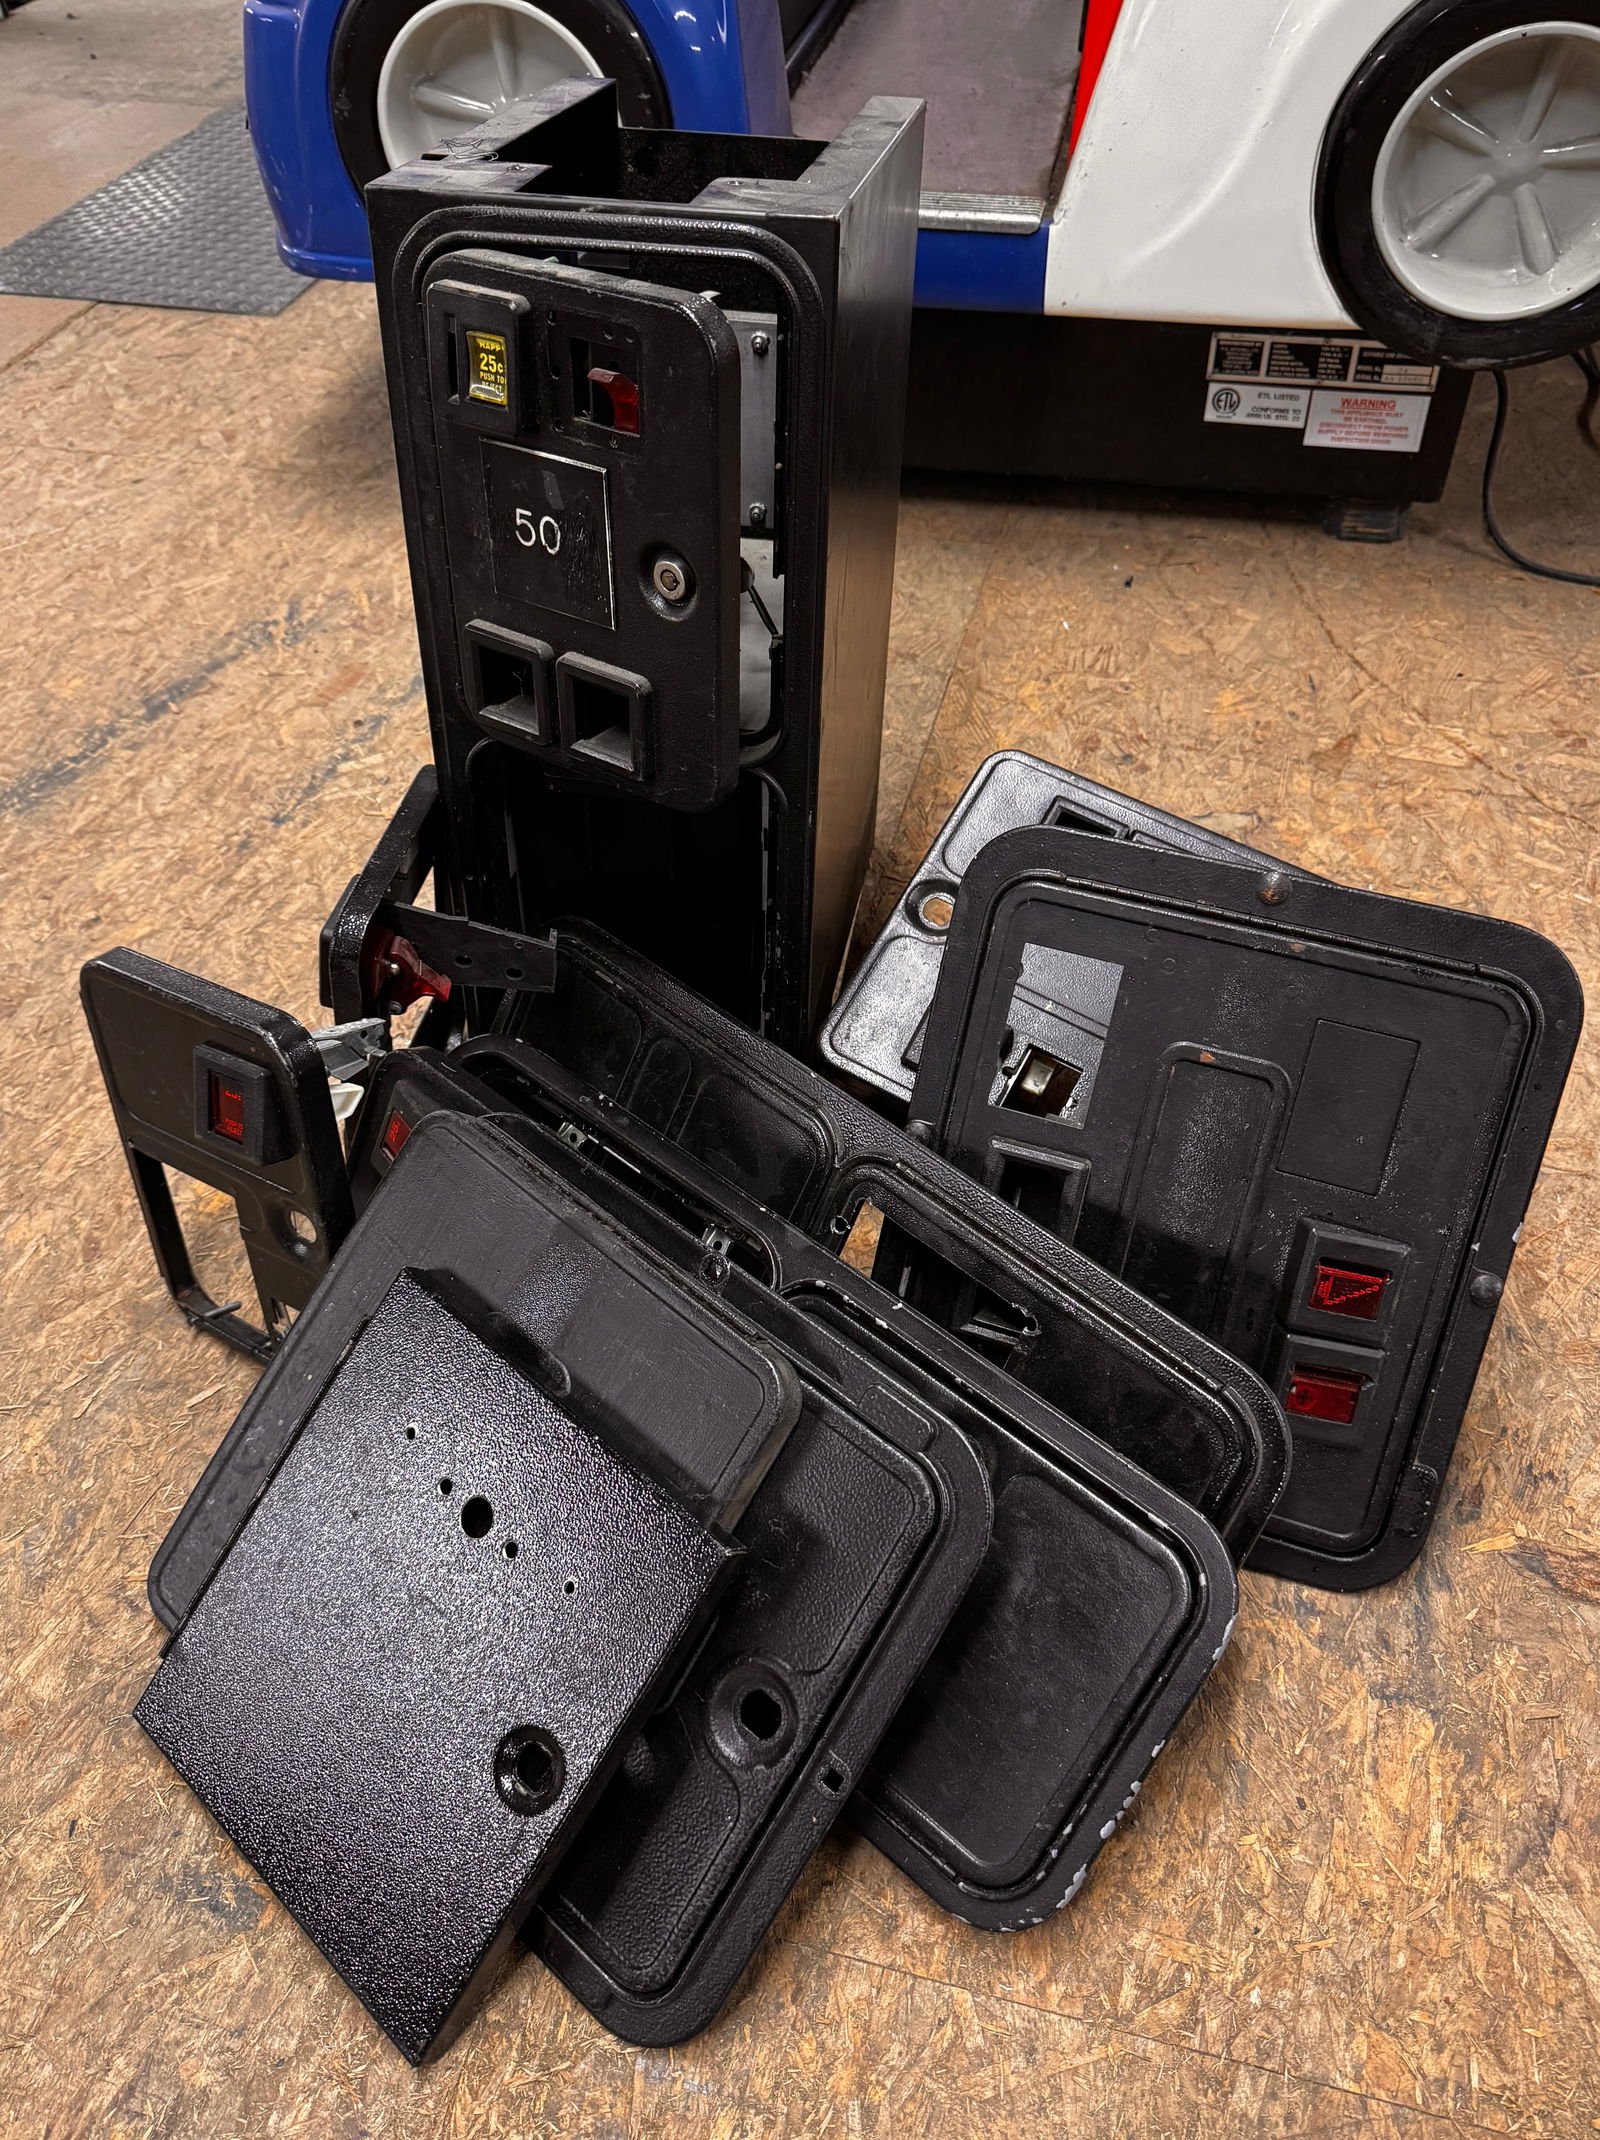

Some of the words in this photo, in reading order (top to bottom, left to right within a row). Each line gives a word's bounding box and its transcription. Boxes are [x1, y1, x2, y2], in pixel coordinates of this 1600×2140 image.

[479, 371, 495, 382] PUSH
[496, 375, 505, 383] TO
[1257, 392, 1272, 400] ETL
[1274, 393, 1300, 401] LISTED
[1341, 397, 1397, 410] WARNING
[1251, 406, 1290, 414] CONFORMS
[514, 507, 562, 556] 50
